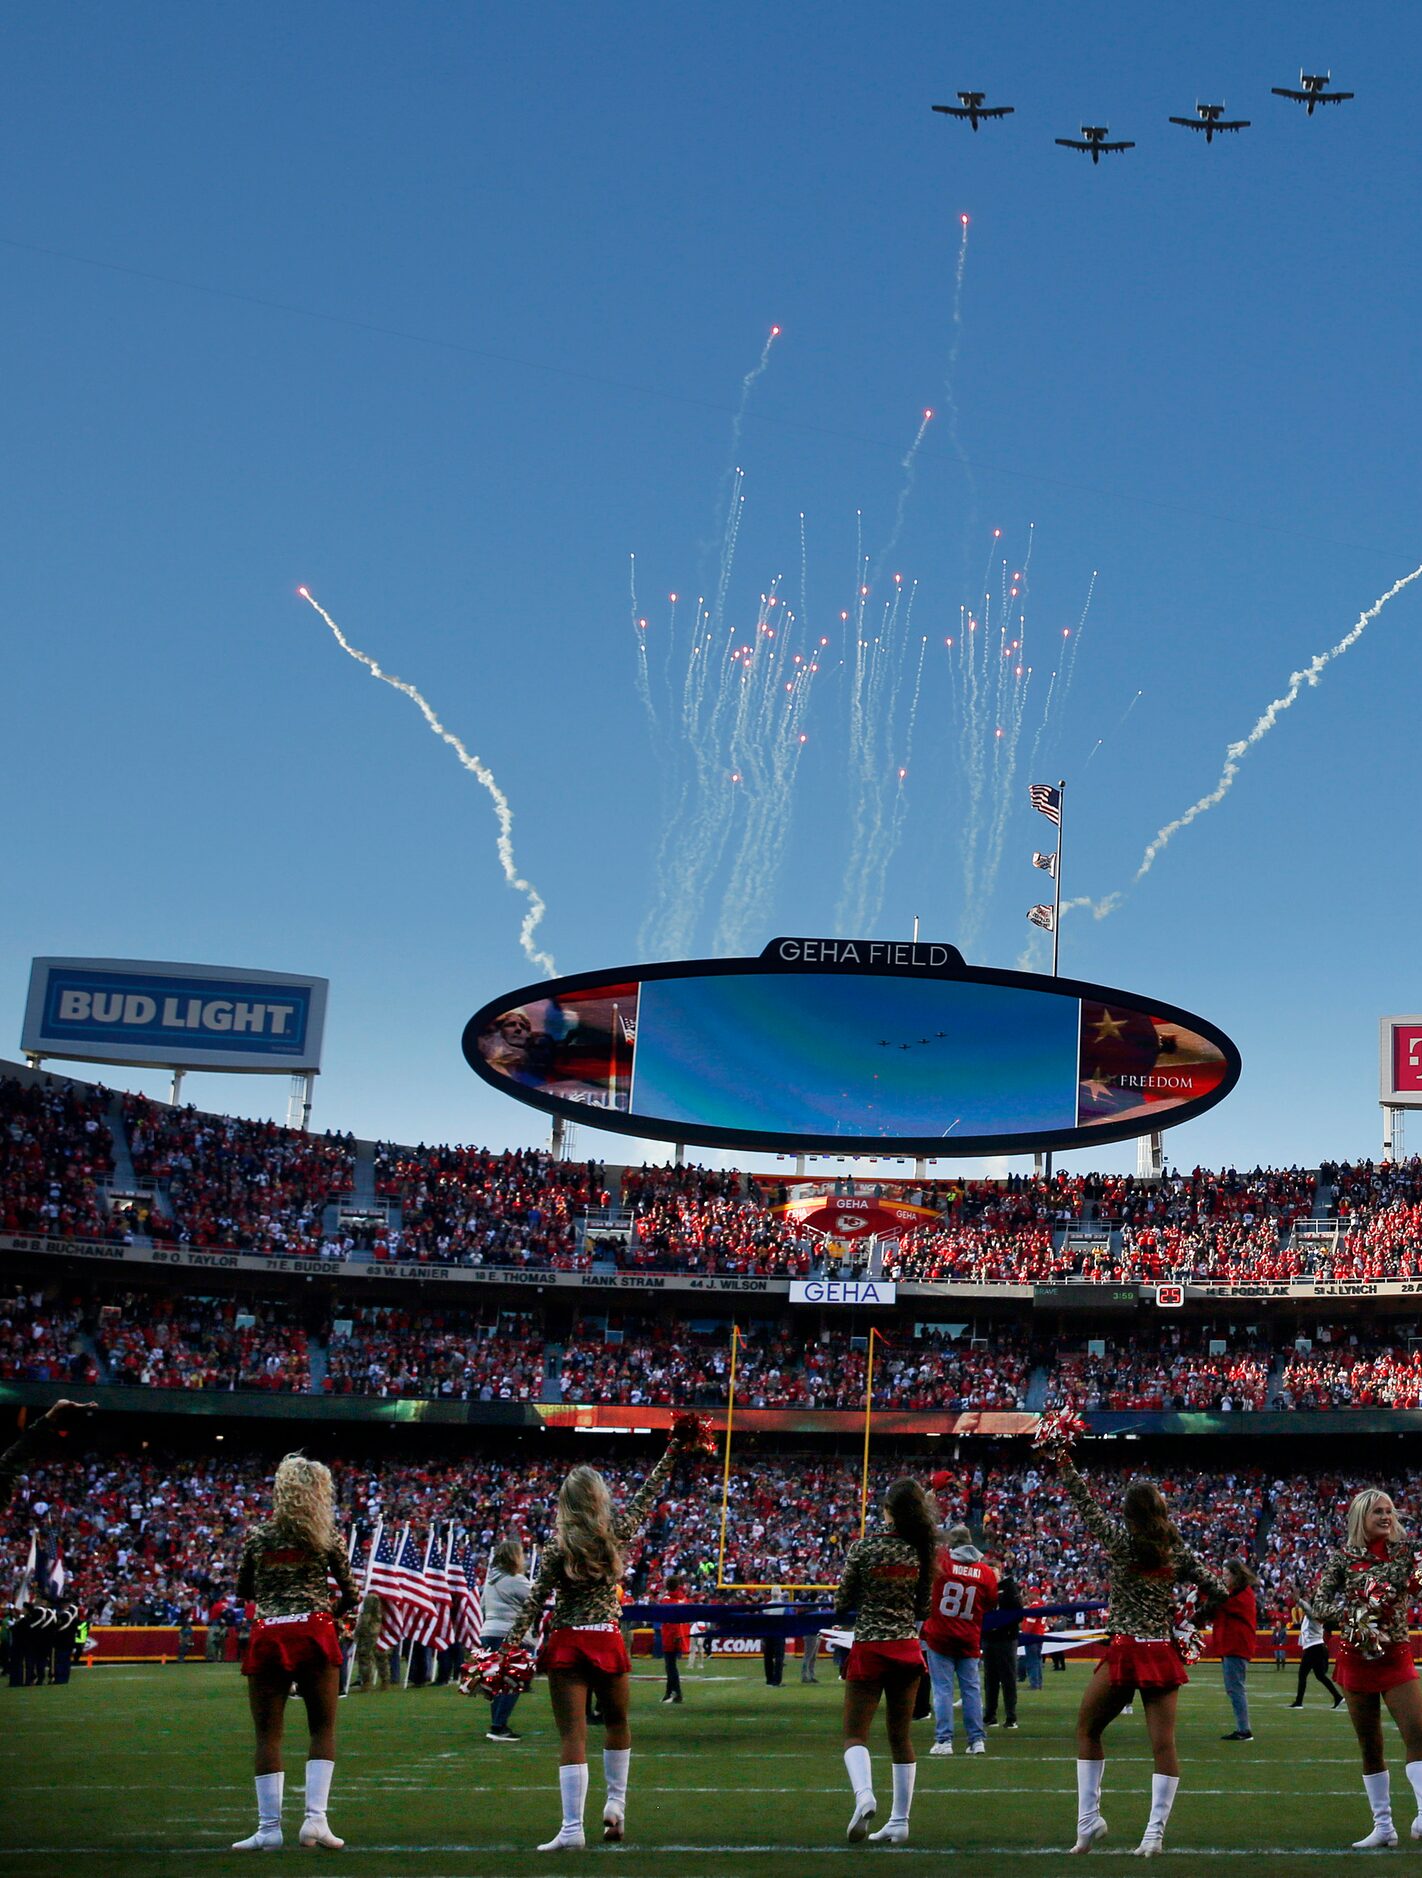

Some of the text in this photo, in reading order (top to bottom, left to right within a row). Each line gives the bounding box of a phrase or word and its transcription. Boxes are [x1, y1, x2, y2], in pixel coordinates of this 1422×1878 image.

[778, 940, 948, 966] GEHA FIELD
[59, 990, 294, 1034] BUD LIGHT
[1120, 1075, 1193, 1089] FREEDOM
[837, 1199, 869, 1209] GEHA
[896, 1210, 917, 1221] GEHA
[47, 1241, 124, 1258] BUCHANAN
[188, 1254, 238, 1266] TAYLOR
[279, 1260, 292, 1271] E.
[294, 1261, 340, 1273] BUDDE
[401, 1267, 449, 1278] LANIER
[489, 1272, 499, 1281] E.
[504, 1273, 557, 1284] THOMAS
[582, 1275, 665, 1288] HANK STRAM
[706, 1280, 718, 1291] J.
[721, 1280, 767, 1291] WILSON
[1232, 1286, 1290, 1297] PODOLAK
[1337, 1285, 1378, 1296] LYNCH
[1401, 1284, 1415, 1293] 28
[804, 1282, 880, 1302] GEHA
[1113, 1292, 1134, 1301] 3:59
[1160, 1287, 1180, 1303] 25
[939, 1581, 977, 1620] 81
